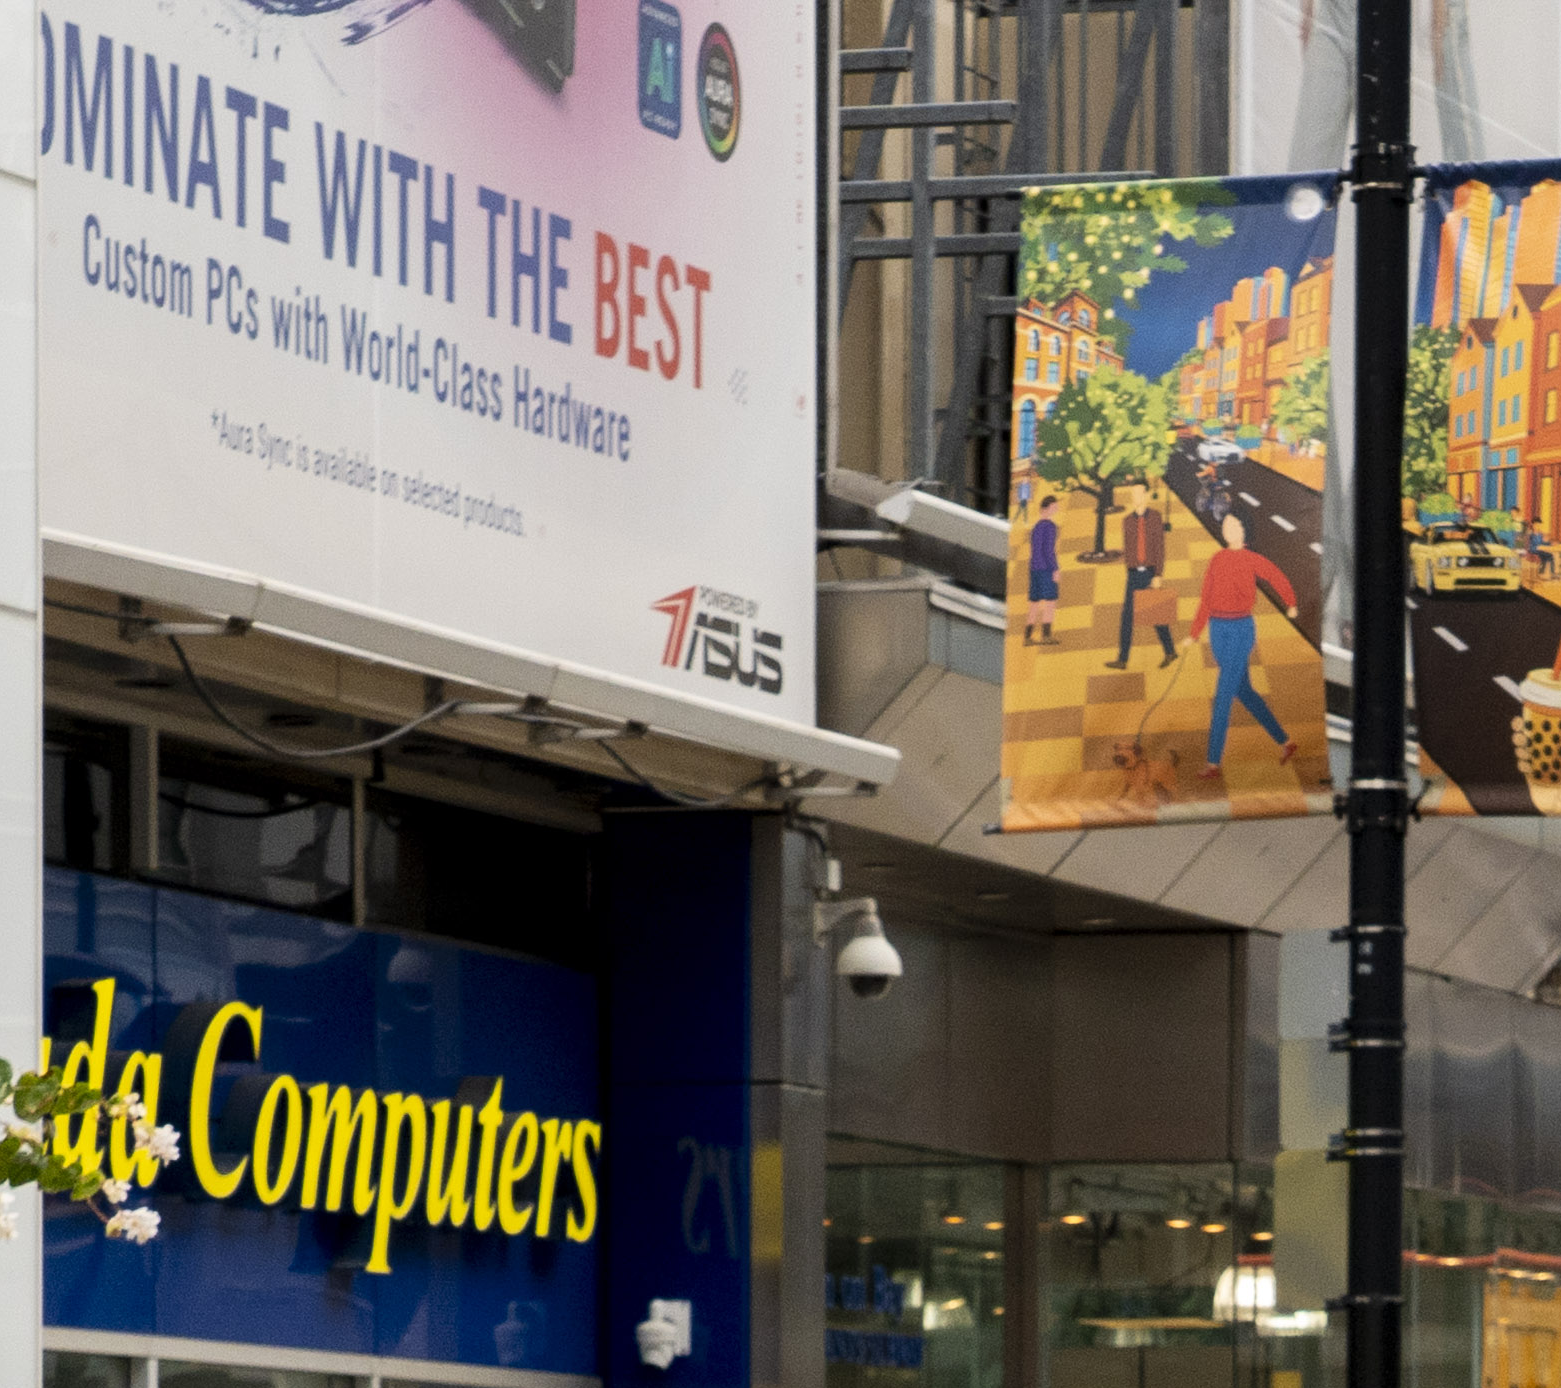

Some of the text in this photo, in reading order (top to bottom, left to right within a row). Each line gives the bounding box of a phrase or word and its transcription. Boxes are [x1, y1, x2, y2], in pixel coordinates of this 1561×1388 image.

[83, 213, 631, 463] Custom PCs with World-Class Hardware
[315, 121, 455, 304] WITH
[477, 185, 573, 346] THE
[594, 230, 712, 390] BEST
[189, 1001, 602, 1275] Computers
